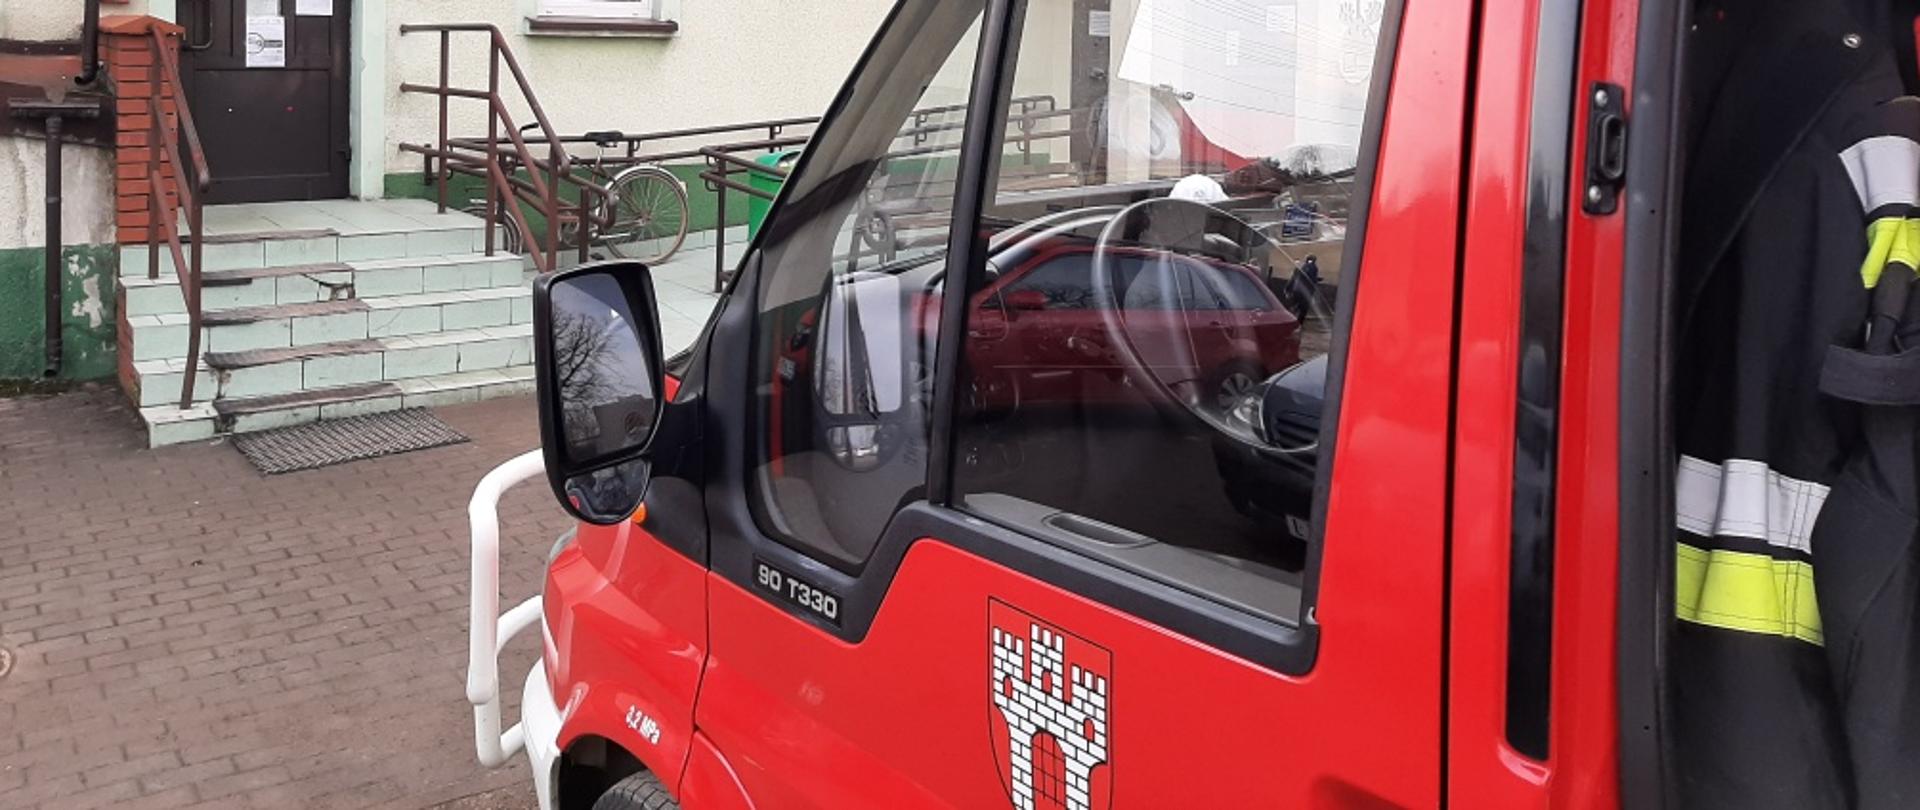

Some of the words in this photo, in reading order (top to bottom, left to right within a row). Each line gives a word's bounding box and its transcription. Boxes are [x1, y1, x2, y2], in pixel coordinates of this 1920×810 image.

[758, 564, 782, 592] 90
[787, 578, 837, 619] T330
[640, 715, 660, 745] MPa
